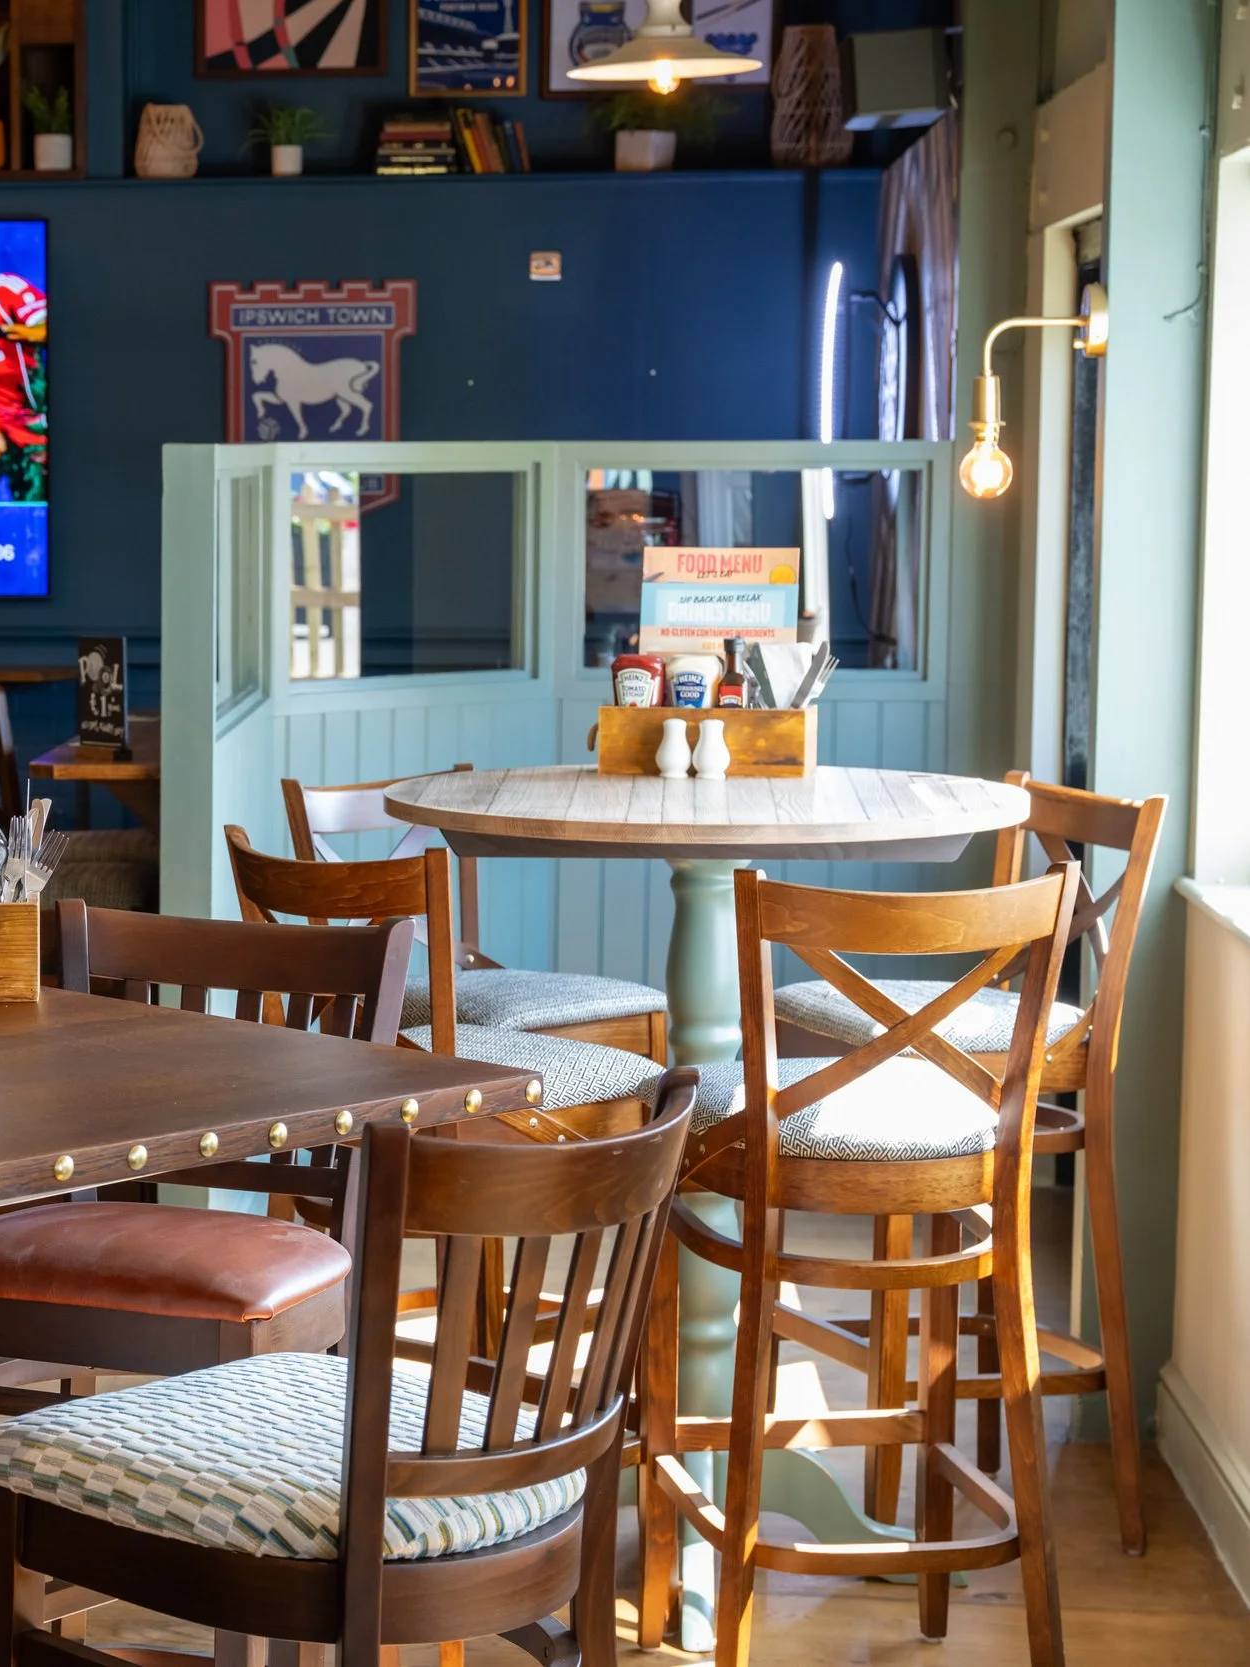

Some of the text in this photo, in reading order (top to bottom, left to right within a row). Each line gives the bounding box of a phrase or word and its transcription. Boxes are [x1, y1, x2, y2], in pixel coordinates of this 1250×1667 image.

[239, 307, 386, 324] IPSWICH TOWN
[678, 554, 763, 574] FOOD MENU
[693, 595, 715, 603] BACK
[716, 595, 734, 603] AND
[736, 593, 762, 602] RELAX
[728, 602, 771, 622] MENU
[624, 673, 644, 682] HEINZ
[679, 673, 702, 684] HEINZ
